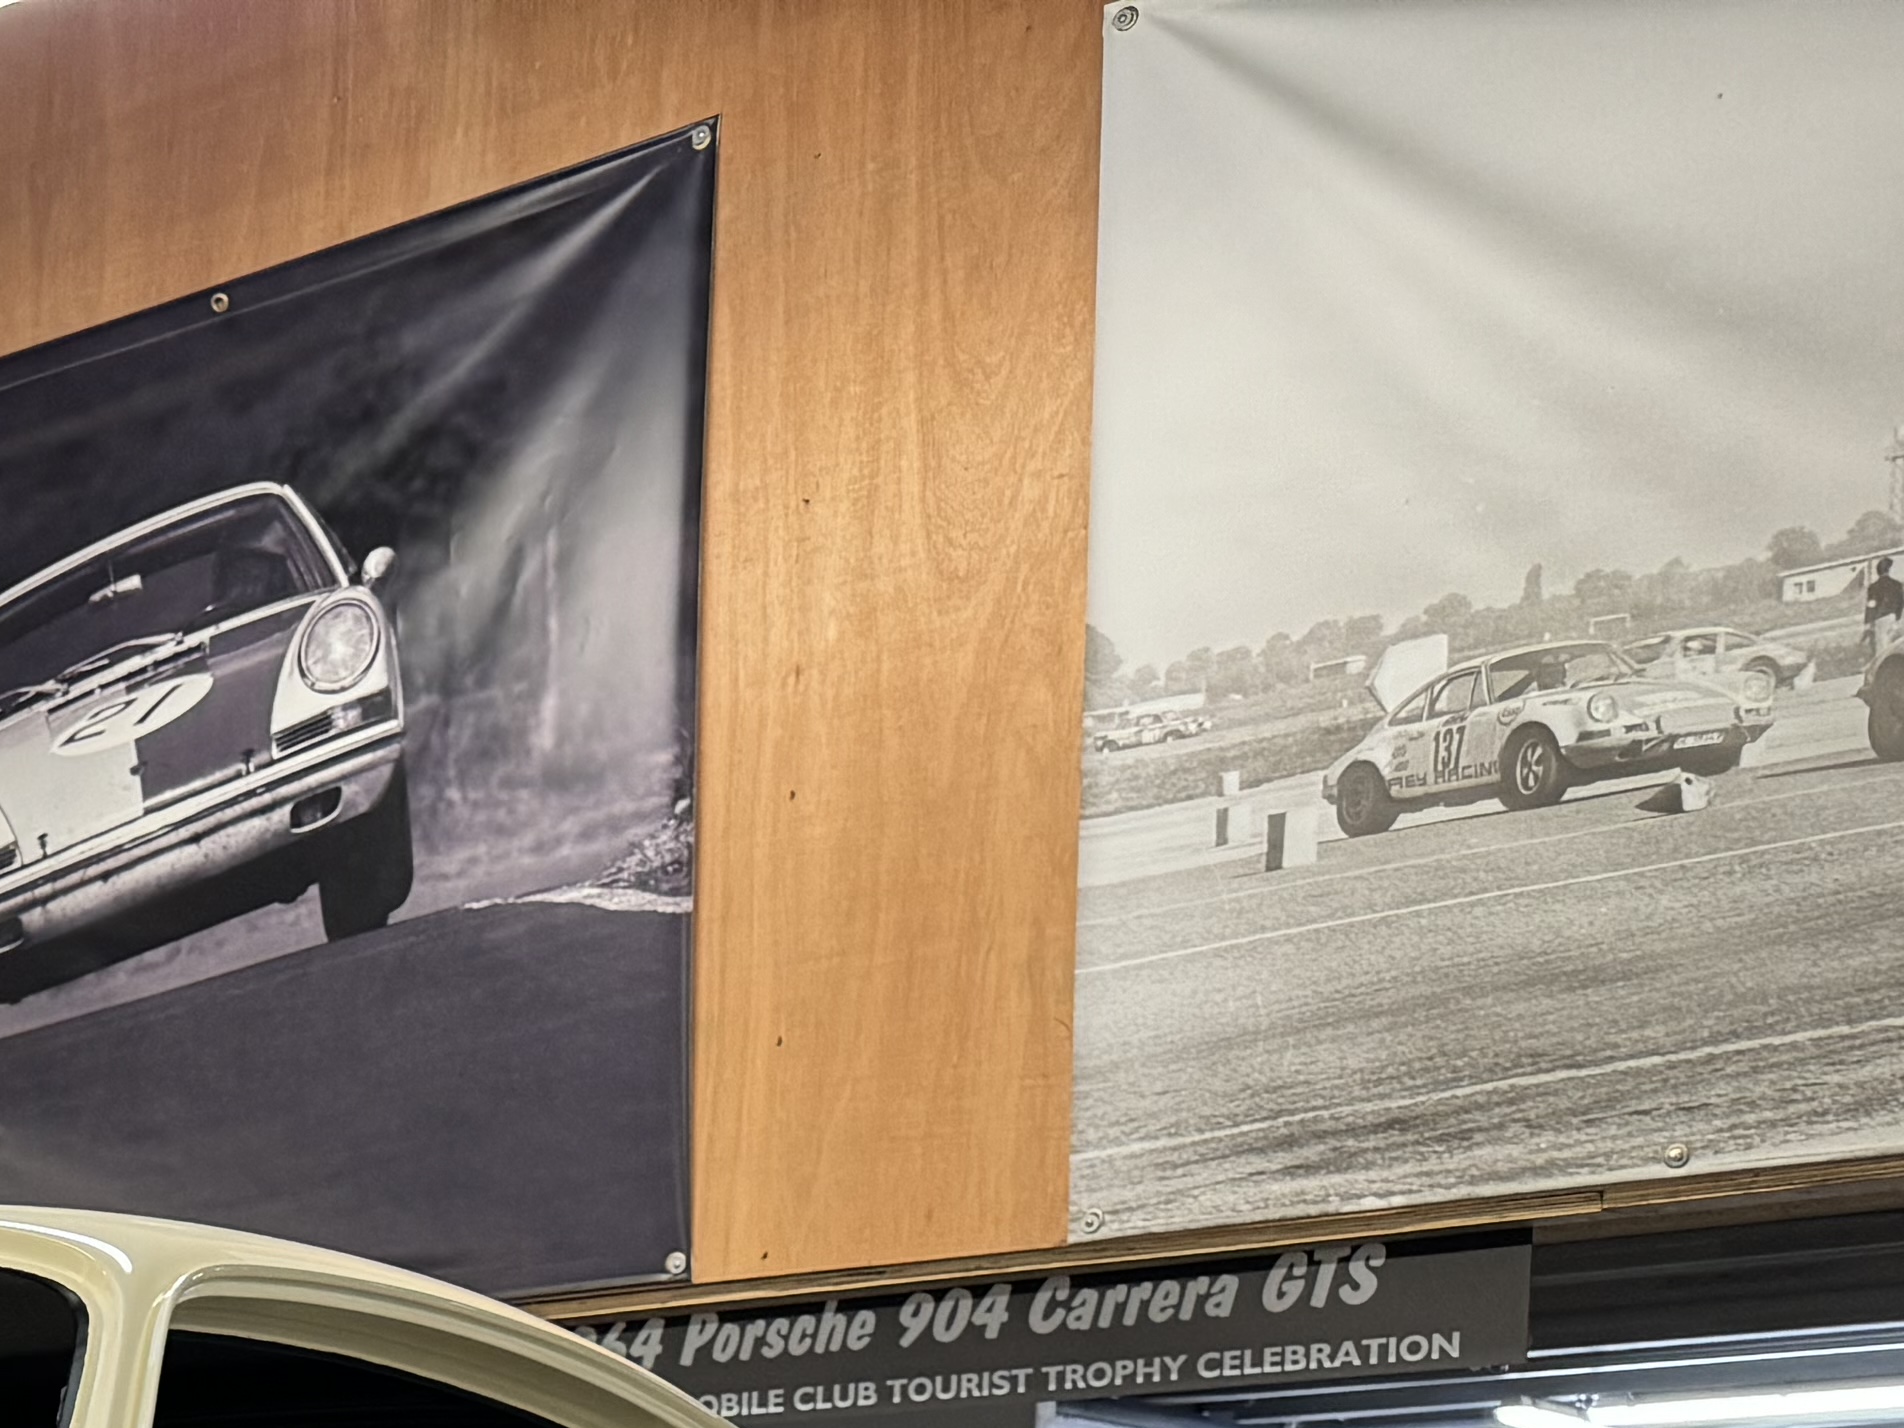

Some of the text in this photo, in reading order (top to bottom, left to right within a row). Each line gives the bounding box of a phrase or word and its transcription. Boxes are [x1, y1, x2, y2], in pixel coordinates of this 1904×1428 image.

[59, 682, 184, 747] 21
[1433, 725, 1466, 771] 137
[680, 1300, 876, 1367] Porsche
[899, 1283, 1012, 1348] 904
[1028, 1274, 1239, 1335] Carrera
[1262, 1242, 1386, 1313] GTS
[699, 1331, 1460, 1418] OBILE CLUB TOURIST TROPHY CELEBRATION
